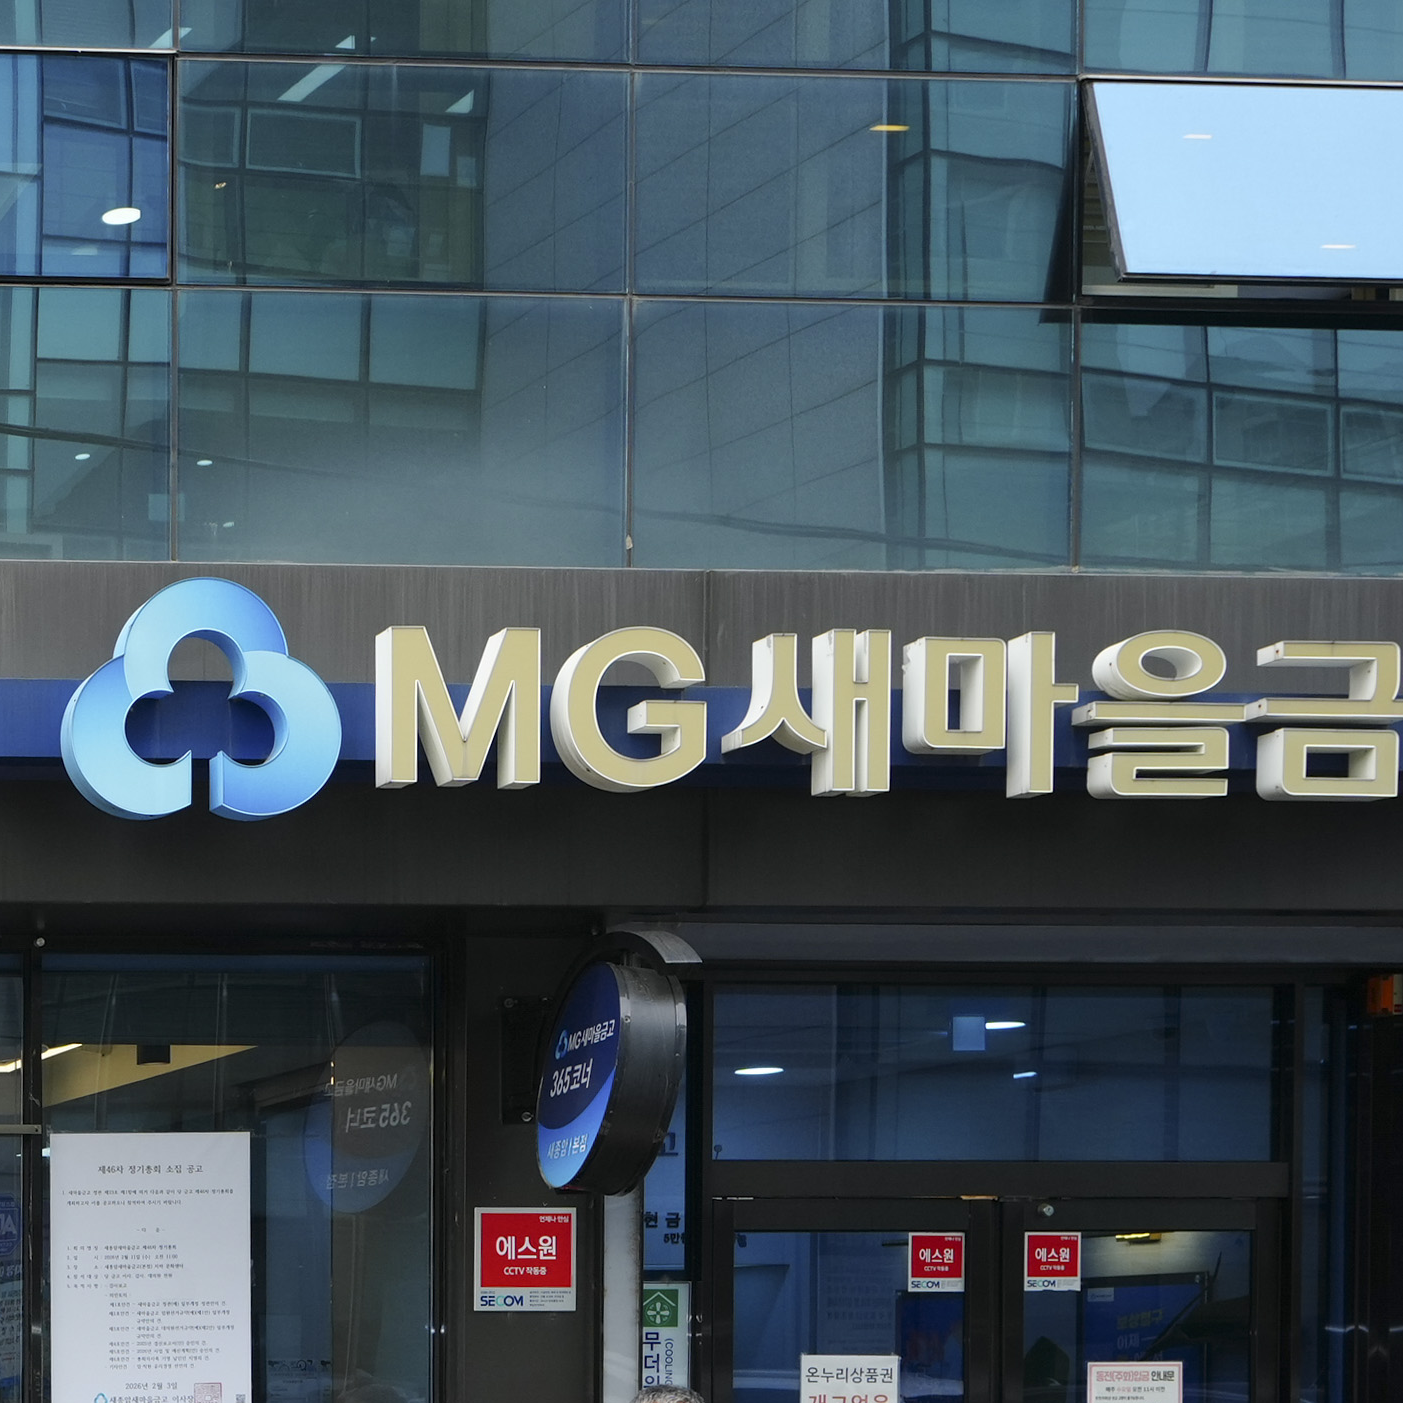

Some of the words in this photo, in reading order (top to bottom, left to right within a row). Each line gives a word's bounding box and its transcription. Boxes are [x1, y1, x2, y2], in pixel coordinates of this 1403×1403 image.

[566, 1018, 616, 1051] MG새마을금고
[97, 1164, 124, 1174] 제46차
[128, 1164, 162, 1174] 정기총회
[166, 1164, 183, 1174] 소집
[187, 1164, 204, 1174] 공고
[495, 1235, 558, 1262] 에스원
[919, 1247, 954, 1264] 에스원
[1034, 1247, 1070, 1263] 에스원
[503, 1266, 525, 1276] CCTV
[525, 1266, 548, 1276] 작동중
[911, 1280, 940, 1289] SECOM
[1026, 1280, 1056, 1288] SECOM
[480, 1295, 524, 1308] SECOM
[805, 1365, 894, 1384] 온누리상품권
[1151, 1370, 1174, 1382] 안내문
[125, 1382, 149, 1391] 2026년
[152, 1382, 165, 1391] 2월
[166, 1382, 178, 1391] 3일
